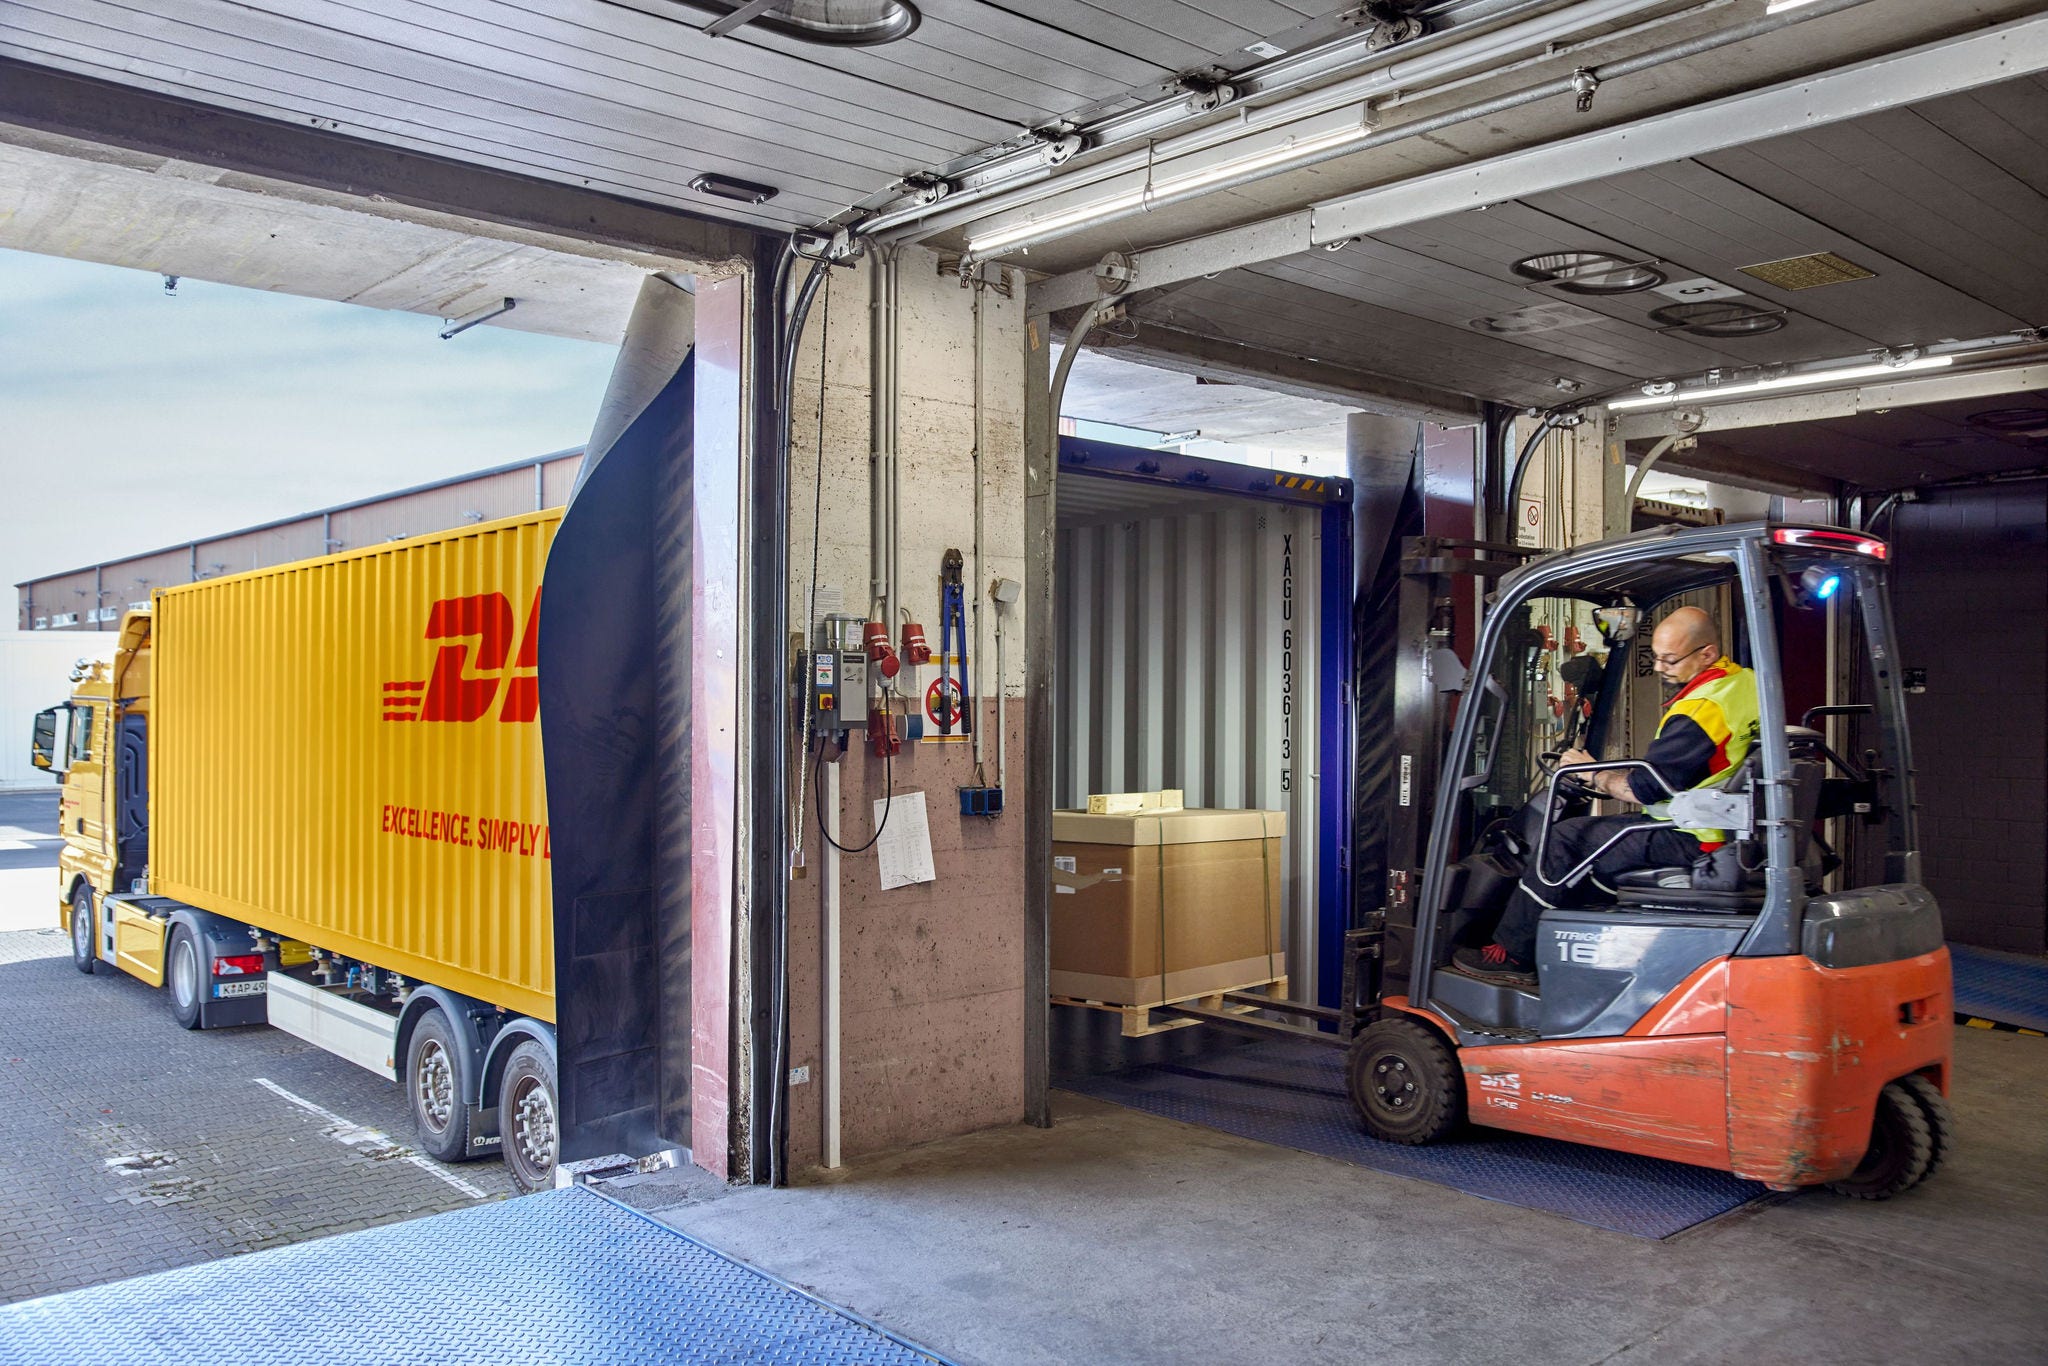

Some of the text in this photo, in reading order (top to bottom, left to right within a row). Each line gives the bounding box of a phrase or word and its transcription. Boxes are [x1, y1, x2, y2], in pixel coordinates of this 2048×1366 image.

[1281, 534, 1292, 792] XAGU 603613 5
[382, 804, 473, 847] EXCELLENCE.
[477, 817, 541, 857] SIMPLY
[1557, 941, 1601, 965] 16
[223, 984, 230, 994] K
[237, 983, 250, 993] AP
